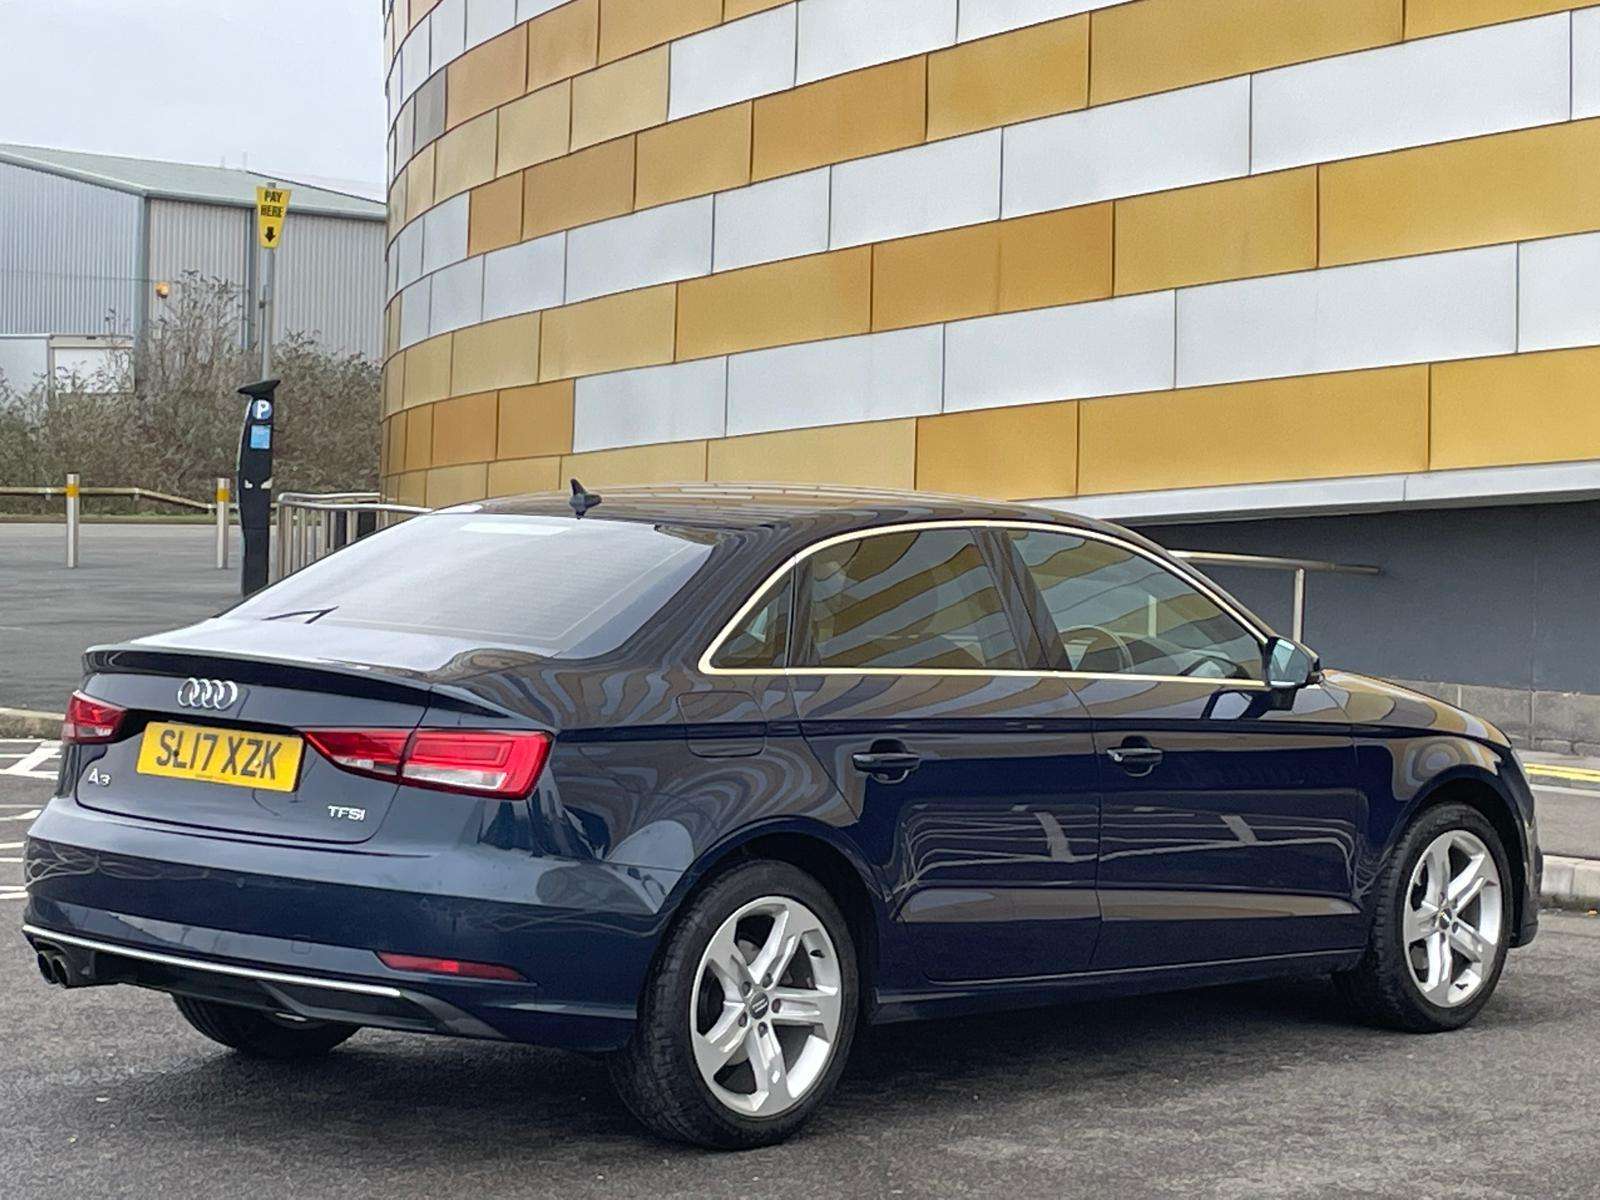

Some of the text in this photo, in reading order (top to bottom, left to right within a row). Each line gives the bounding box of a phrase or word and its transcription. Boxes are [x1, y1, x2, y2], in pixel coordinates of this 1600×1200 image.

[264, 189, 283, 203] PAY
[260, 204, 283, 218] HERE
[256, 400, 270, 420] P
[156, 729, 282, 781] SL17 XZK
[87, 768, 111, 786] A3
[327, 805, 366, 821] TFSI
